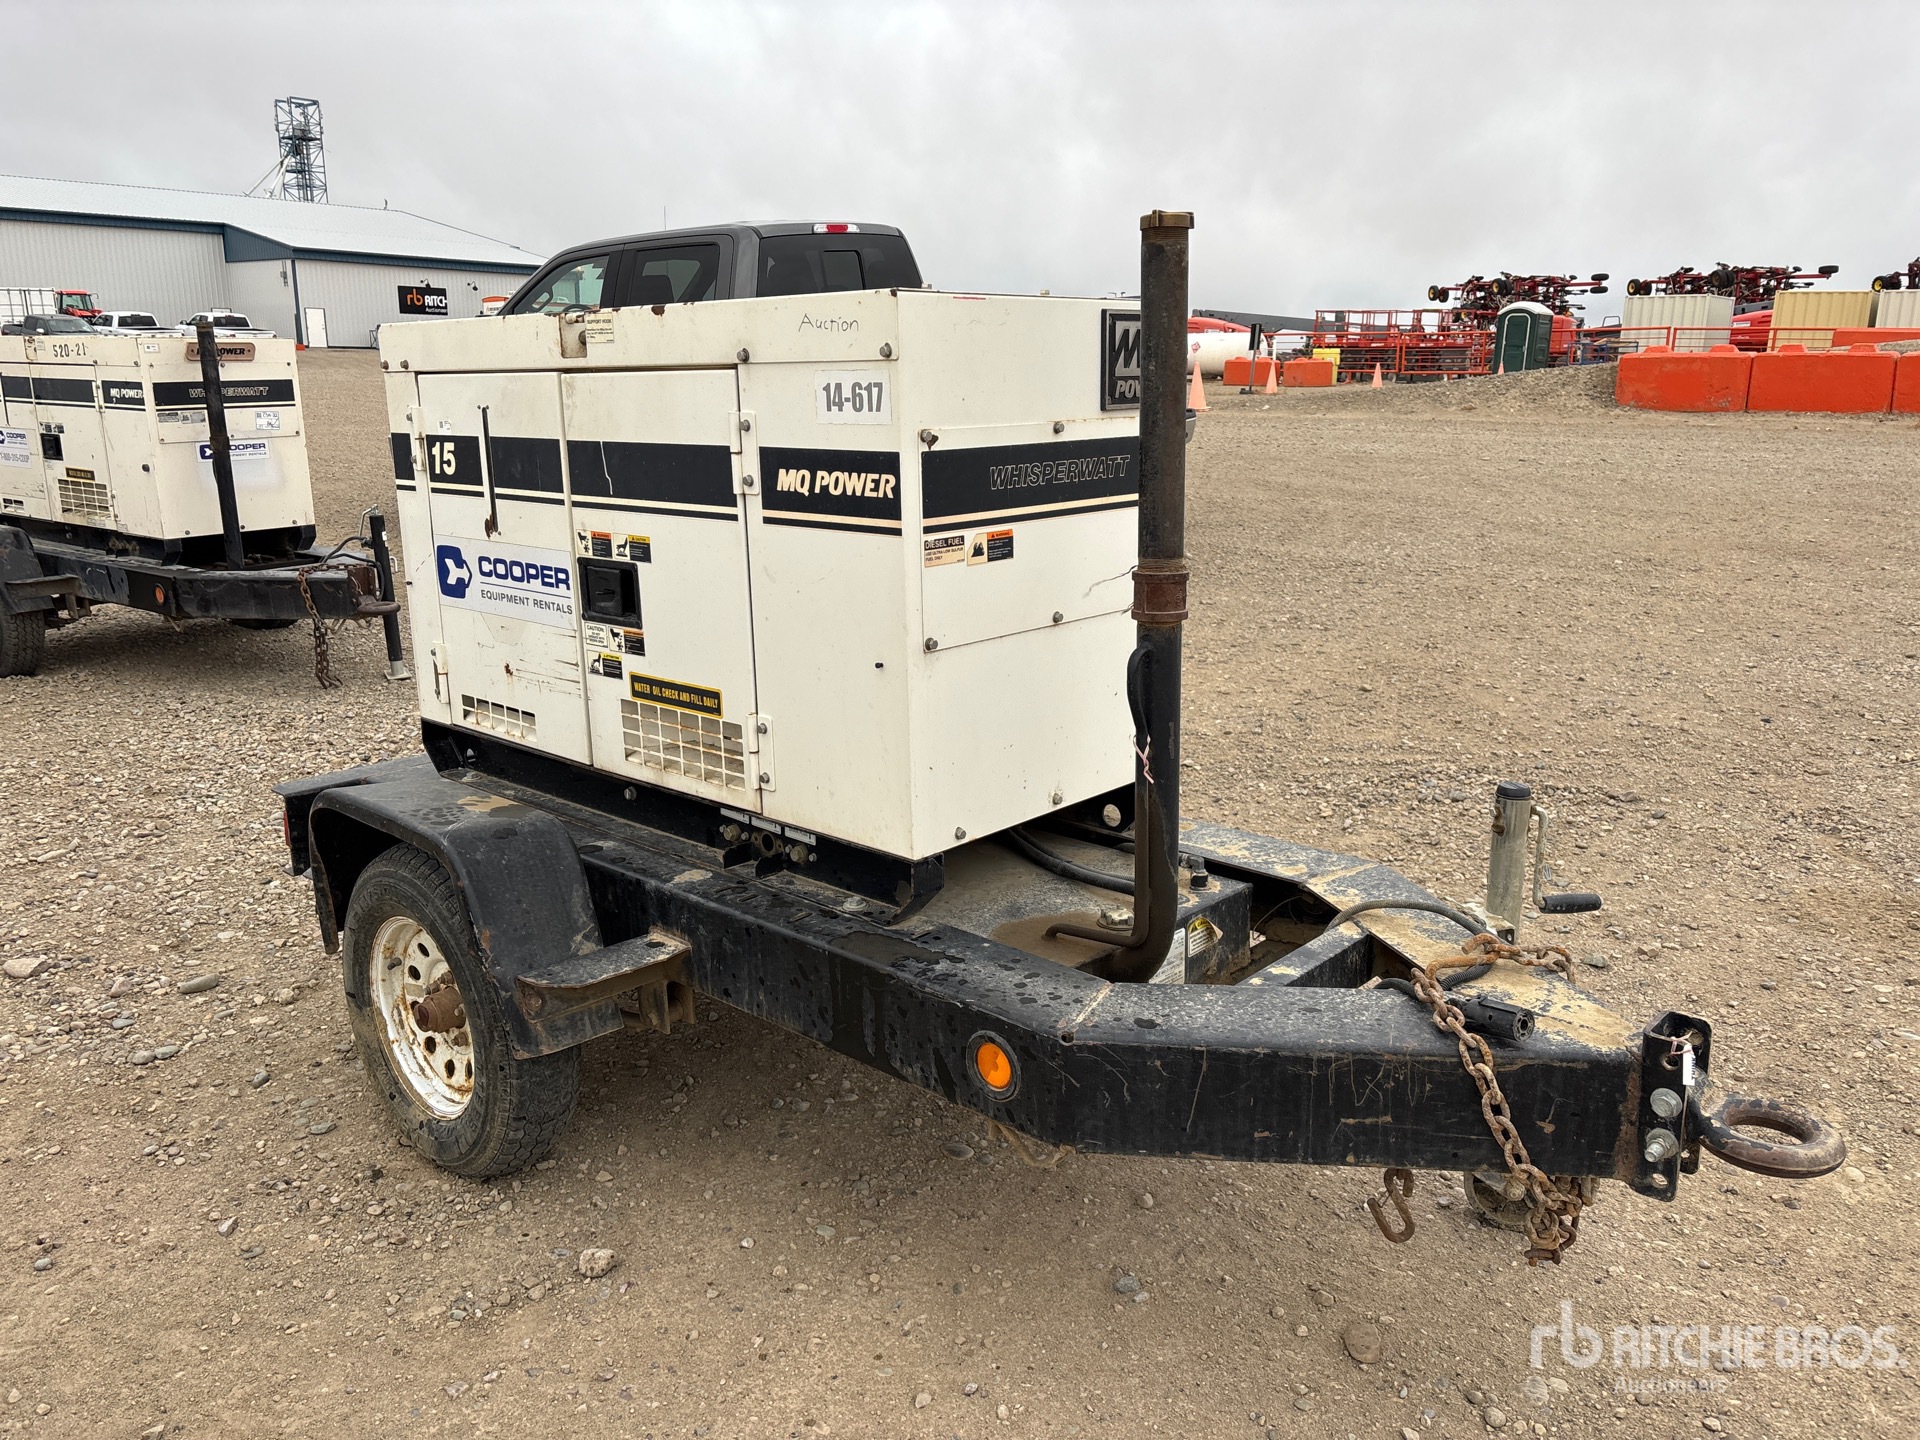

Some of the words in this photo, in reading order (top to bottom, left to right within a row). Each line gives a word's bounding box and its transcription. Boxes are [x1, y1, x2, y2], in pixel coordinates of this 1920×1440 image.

[407, 288, 424, 306] rb
[798, 313, 860, 332] Auction
[53, 342, 87, 358] 520-21
[219, 347, 246, 356] OWER
[110, 388, 120, 398] MQ
[121, 388, 144, 398] POWER
[189, 386, 268, 398] WHPERWATT
[822, 382, 883, 412] 14-617
[6, 432, 26, 440] COOPER
[230, 442, 266, 450] OOPER
[432, 442, 456, 475] 15
[990, 455, 1130, 490] WHISPERWATT
[777, 468, 811, 497] MQ
[814, 470, 896, 498] POWER
[925, 540, 947, 549] DIESEL
[948, 537, 963, 546] FUEL
[478, 556, 571, 590] COOPER
[480, 590, 530, 606] EQUIPMENT
[533, 599, 573, 614] RENTALS
[633, 682, 650, 694] WATER
[652, 686, 661, 696] OIL
[662, 688, 679, 700] CHECK
[680, 691, 690, 702] AND
[691, 694, 702, 705] FILL
[703, 696, 718, 708] DAILY
